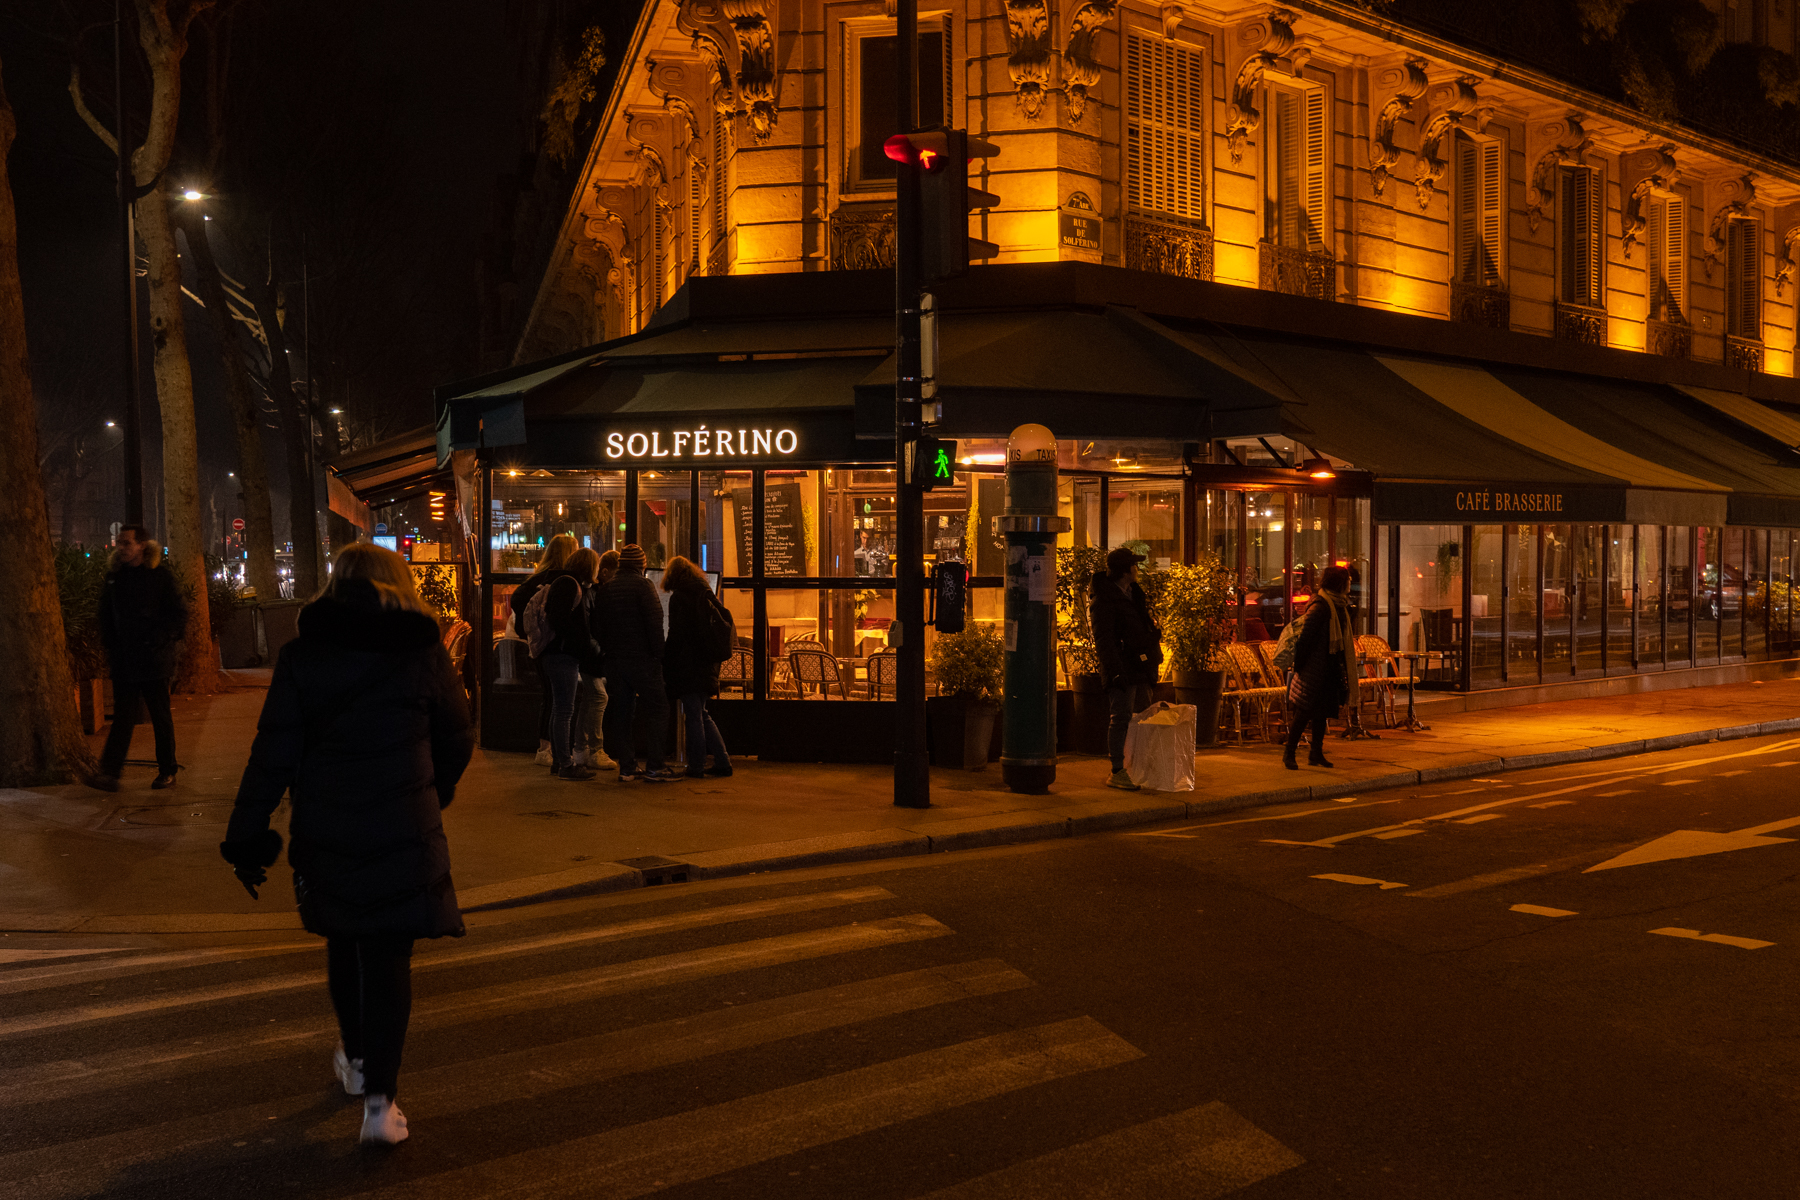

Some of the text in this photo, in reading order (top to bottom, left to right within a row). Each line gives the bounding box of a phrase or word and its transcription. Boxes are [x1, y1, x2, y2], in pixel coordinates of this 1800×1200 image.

[1073, 218, 1087, 228] RUE
[1076, 229, 1086, 237] DE
[1063, 236, 1098, 249] SOLFÉRINO
[606, 424, 798, 458] SOLFÉRINO
[1036, 449, 1056, 461] TAXIS
[1456, 488, 1563, 512] CAFÉ BRASSERIE
